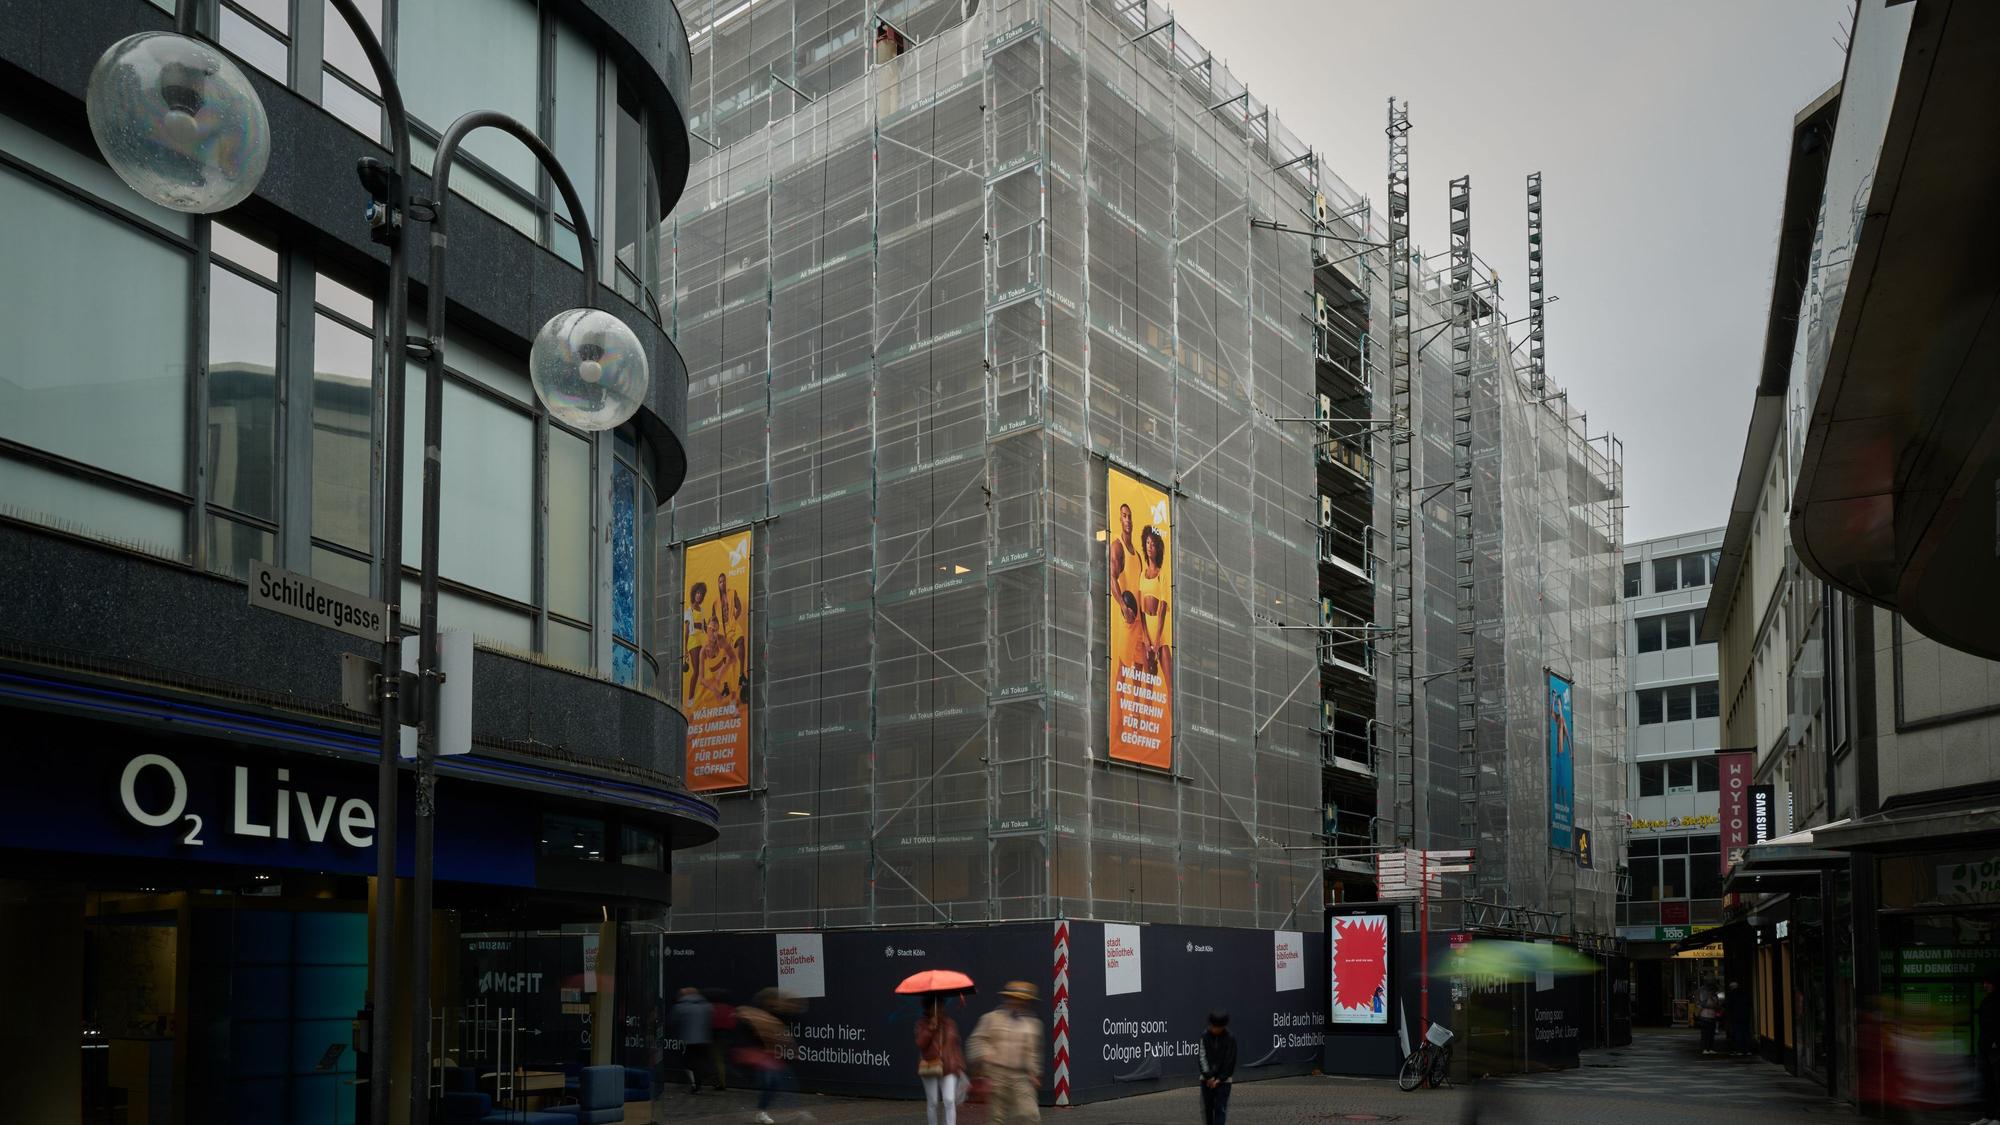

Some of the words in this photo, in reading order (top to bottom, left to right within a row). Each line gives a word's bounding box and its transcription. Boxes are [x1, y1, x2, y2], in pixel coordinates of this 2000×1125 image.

[998, 293, 1006, 302] Ali
[1008, 287, 1025, 298] Tokus
[999, 424, 1008, 432] Ali
[1009, 419, 1026, 430] Tokus
[1001, 555, 1009, 564] Ali
[1010, 551, 1028, 562] Tokus
[260, 570, 380, 631] Schildergasse
[1121, 665, 1162, 687] WÄHREND
[1001, 688, 1009, 696] Ali
[1010, 686, 1028, 695] Tokus
[1116, 680, 1132, 694] DES
[1133, 685, 1167, 705] UMBAUS
[693, 704, 737, 721] WÄHREND
[1120, 698, 1164, 719] WEITERHIN
[687, 722, 704, 736] DES
[704, 718, 742, 732] UMBAUS
[1122, 713, 1138, 729] FÜR
[1139, 720, 1160, 734] DICH
[691, 733, 737, 749] WEITERHIN
[1121, 731, 1161, 749] GEÖFFNET
[695, 750, 712, 762] FÜR
[712, 748, 734, 760] DICH
[693, 762, 736, 777] GEÖFFNET
[233, 765, 376, 848] Live
[1730, 763, 1742, 843] WOYTON
[1001, 821, 1009, 829] Ali
[1010, 820, 1028, 828] Tokus
[1107, 937, 1121, 947] stadt
[1276, 943, 1289, 951] stadt
[779, 947, 798, 956] stadt
[897, 949, 912, 957] Stadt
[913, 949, 926, 957] Köln
[1107, 947, 1134, 958] bibliothek
[1276, 951, 1299, 960] bibliothek
[1902, 948, 1941, 960] WARUM
[779, 955, 815, 965] bibliothek
[1107, 959, 1119, 968] köln
[1276, 961, 1287, 969] köln
[780, 965, 795, 975] köln
[1903, 963, 1921, 973] NEU
[494, 972, 543, 993] McFIT
[1273, 1012, 1291, 1027] Bald
[1292, 1012, 1311, 1026] auch
[804, 1023, 835, 1039] auch
[838, 1024, 866, 1041] hier:
[1102, 1018, 1138, 1038] Coming
[1140, 1020, 1168, 1034] soon:
[1273, 1034, 1286, 1048] Die
[774, 1044, 795, 1061] Die
[798, 1045, 891, 1068] Stadtbibliothek
[1102, 1043, 1141, 1064] Cologne
[1143, 1041, 1174, 1058] Public
